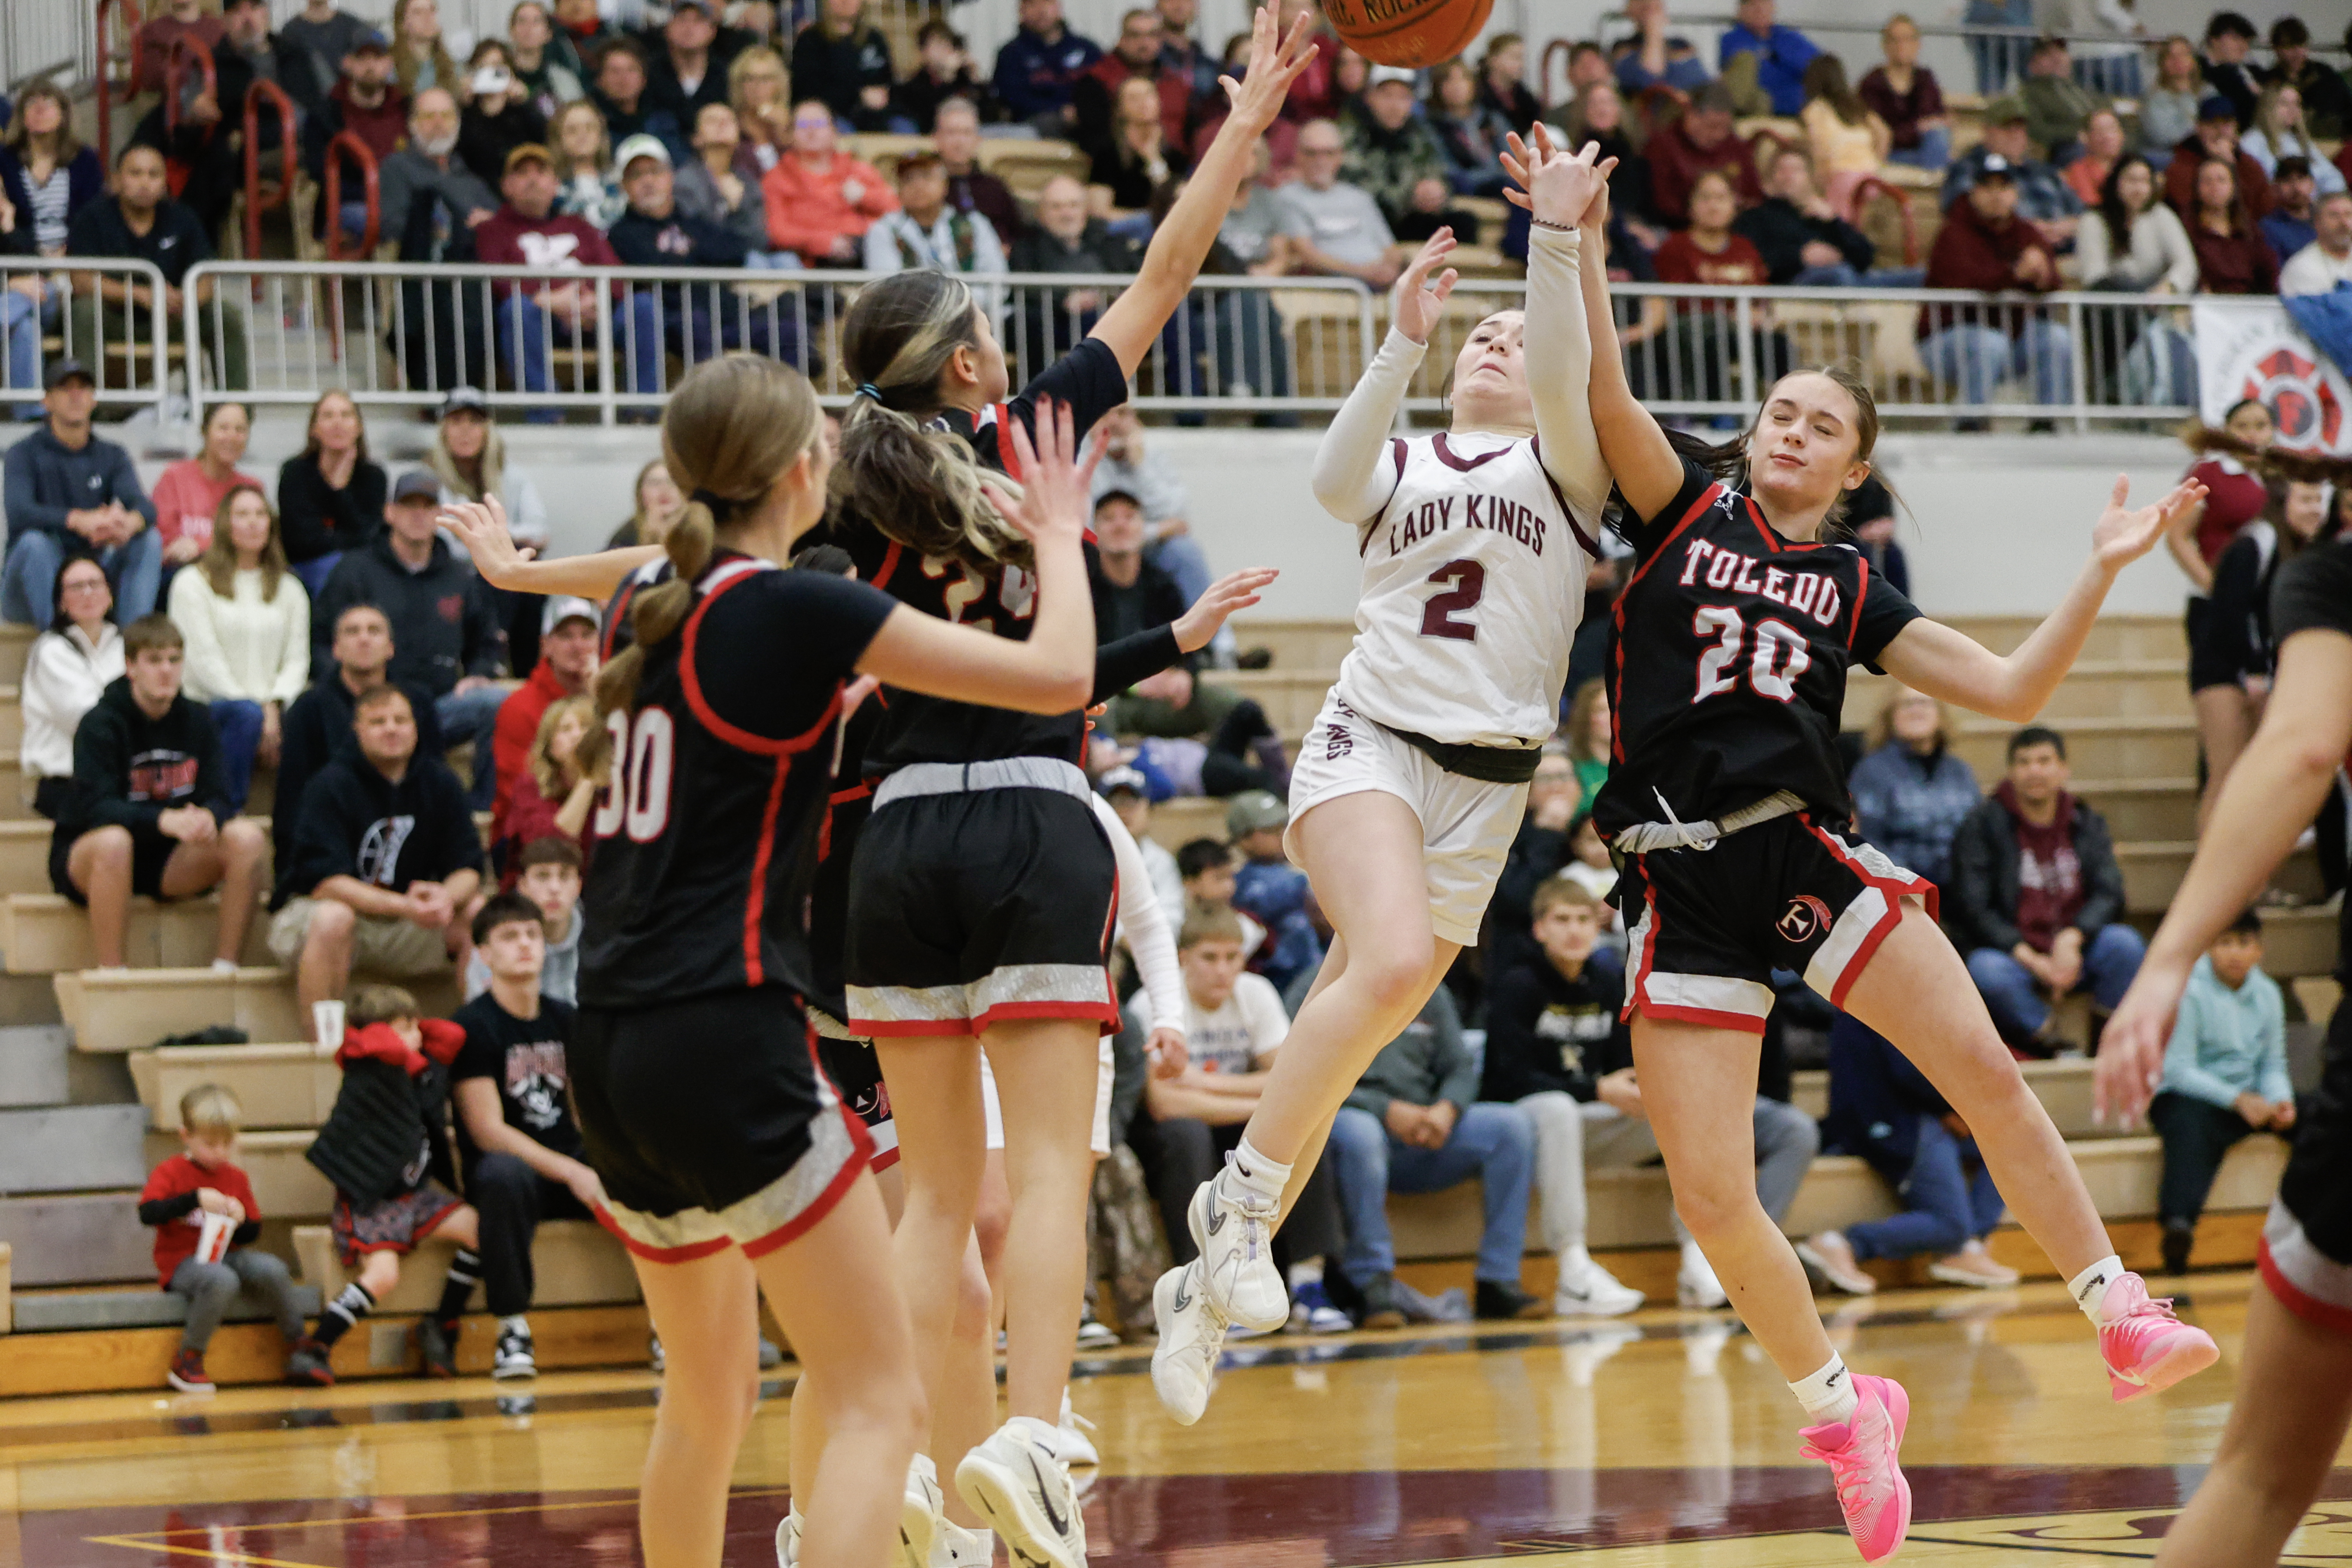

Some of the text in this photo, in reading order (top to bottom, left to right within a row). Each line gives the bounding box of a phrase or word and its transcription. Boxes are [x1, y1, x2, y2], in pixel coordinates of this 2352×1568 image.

[1390, 494, 1546, 557] LADY KINGS
[1417, 557, 1488, 645] 2
[1678, 537, 1841, 628] TOLEDO
[1690, 604, 1812, 704] 20
[594, 704, 676, 844] 30
[1326, 723, 1353, 761] KNGS
